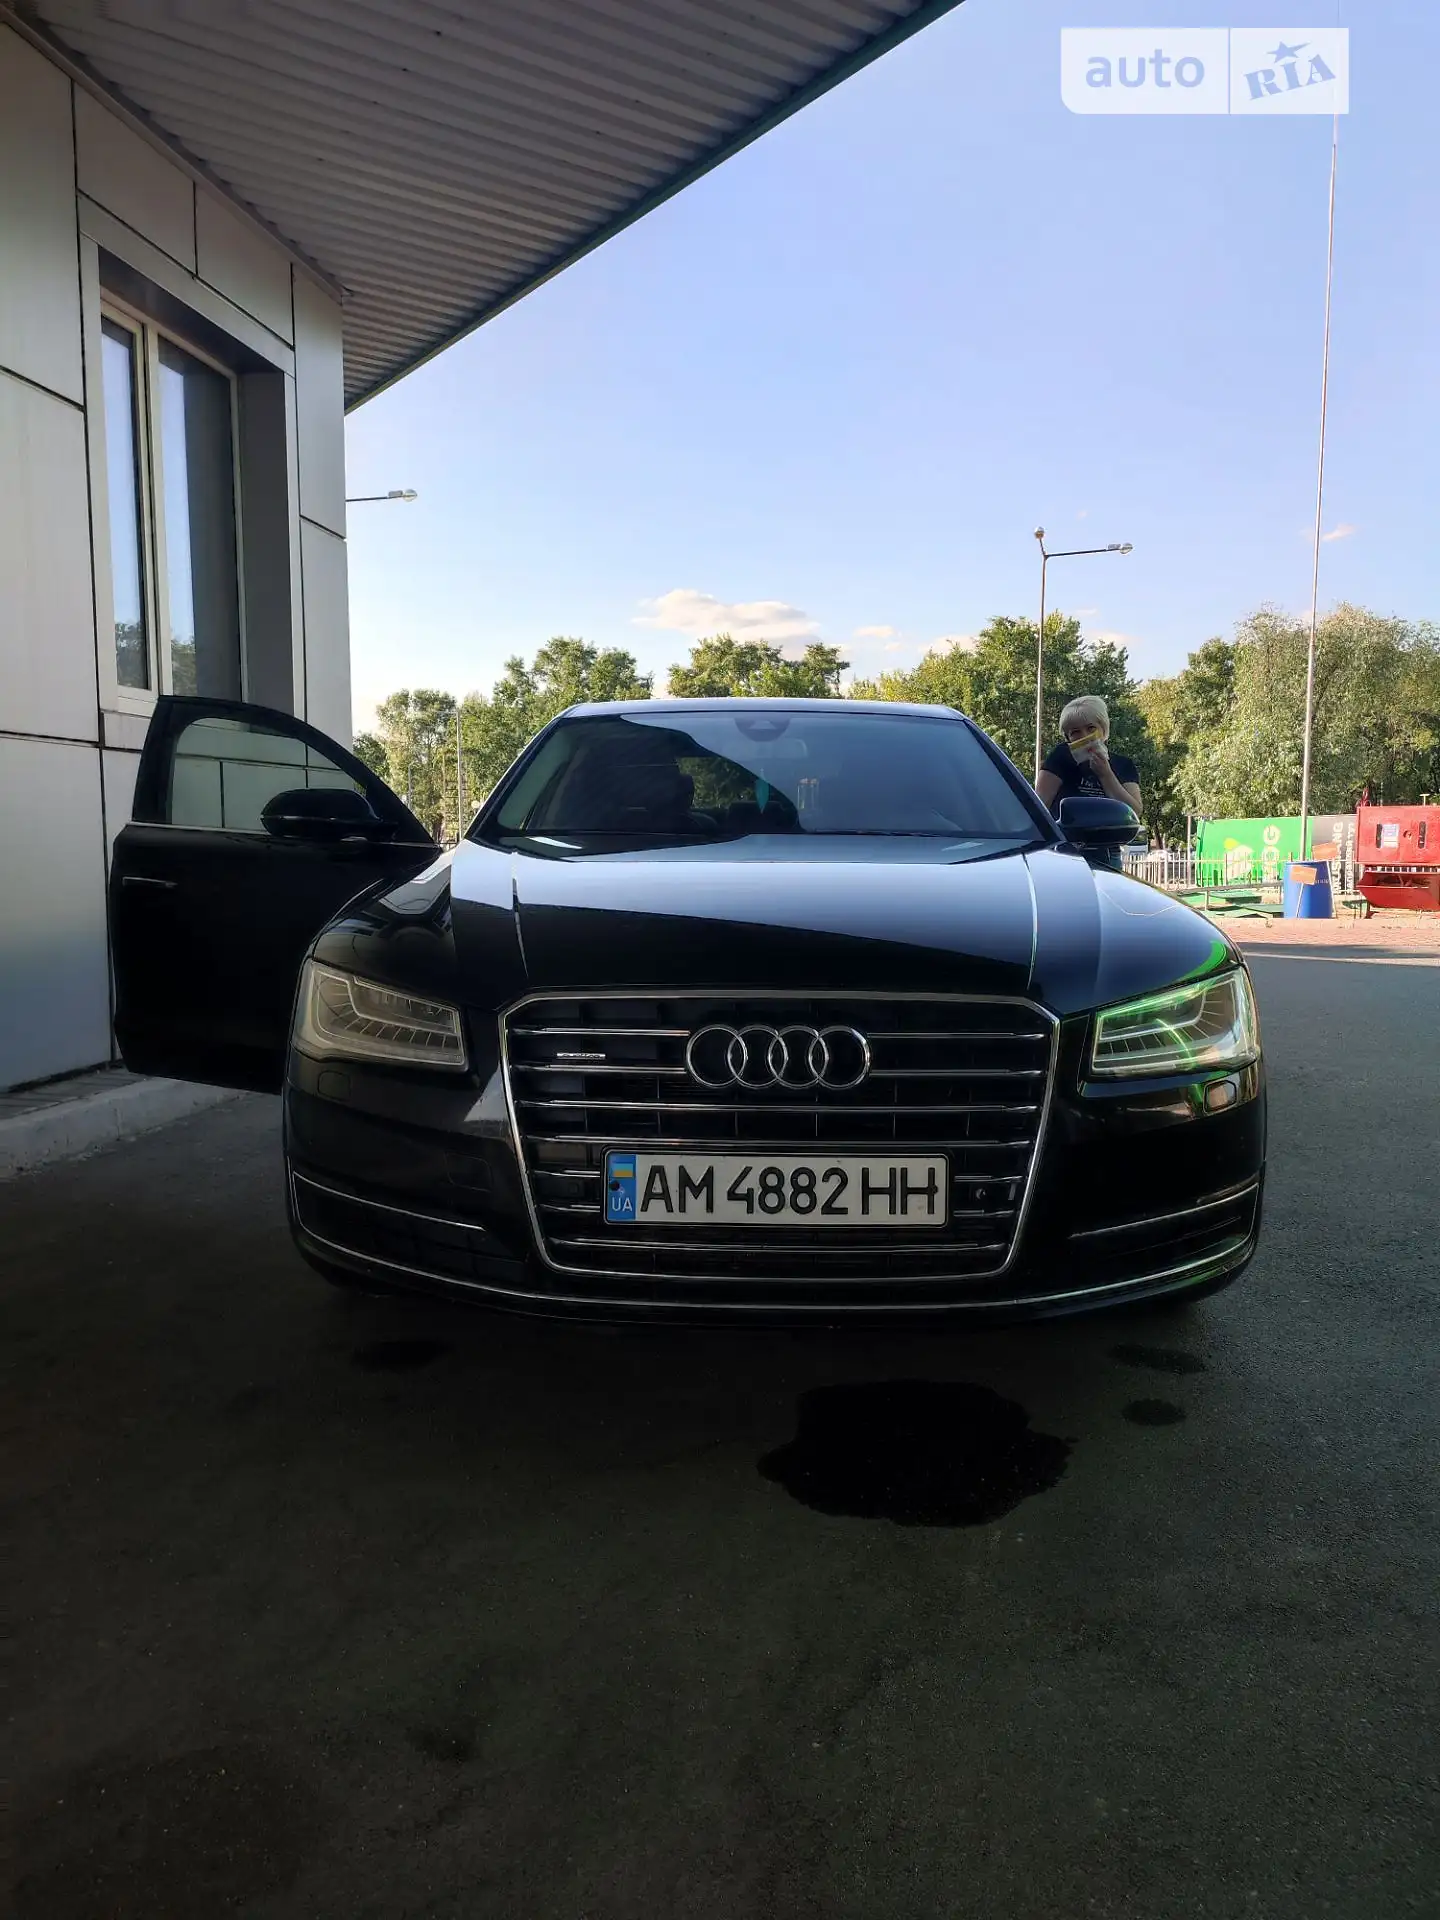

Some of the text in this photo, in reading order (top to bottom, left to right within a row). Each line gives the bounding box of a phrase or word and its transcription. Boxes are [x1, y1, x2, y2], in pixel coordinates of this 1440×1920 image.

[611, 1197, 634, 1213] UA
[640, 1165, 940, 1216] AM 4882 HH
